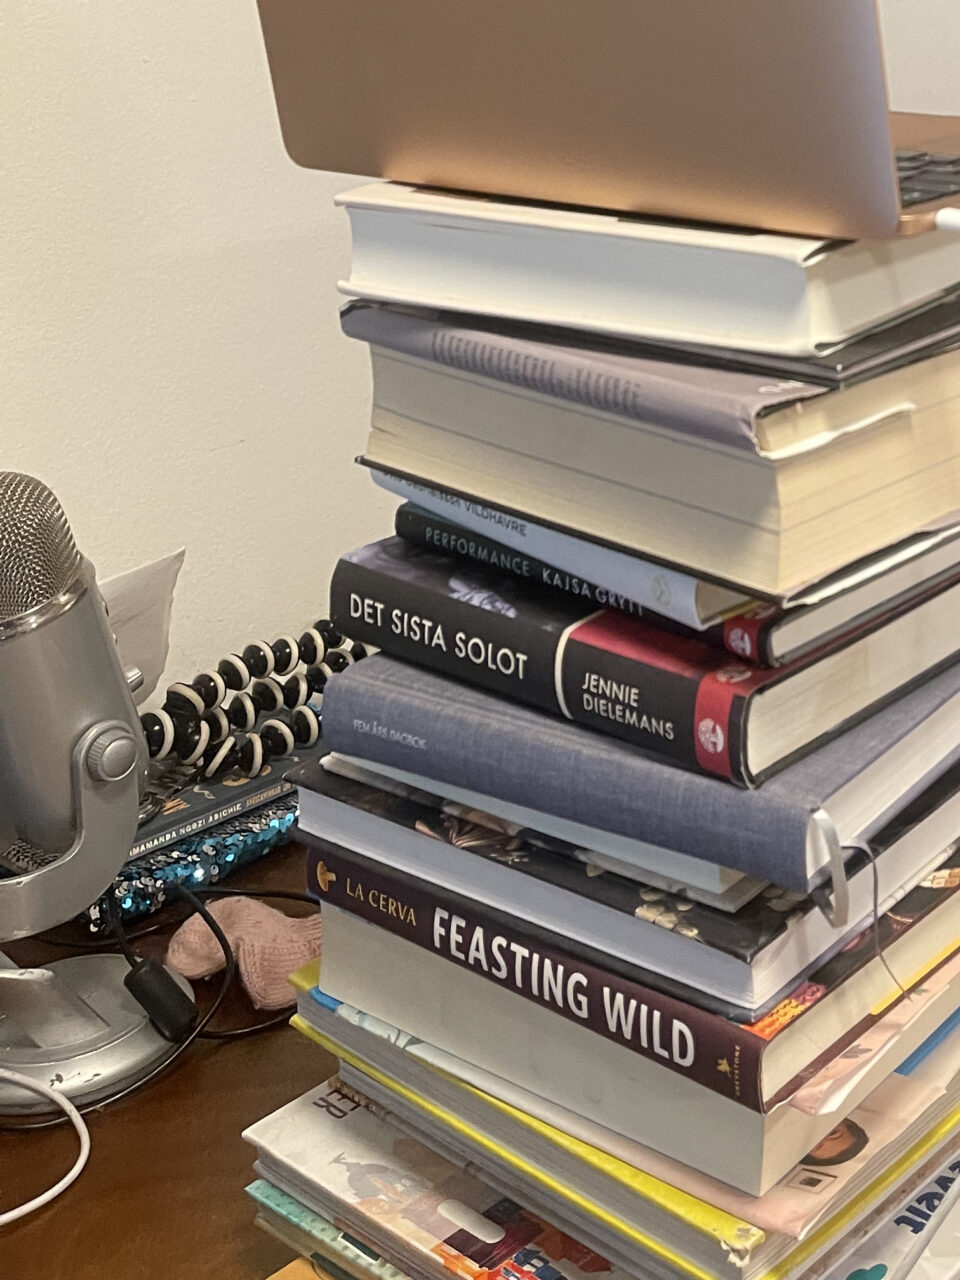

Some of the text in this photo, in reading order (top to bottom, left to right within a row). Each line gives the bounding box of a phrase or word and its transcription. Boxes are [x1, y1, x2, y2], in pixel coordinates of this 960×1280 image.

[425, 526, 530, 577] PERFORMANCE
[542, 568, 591, 599] KAJSA
[350, 593, 528, 680] DET SISTA SOLOT
[582, 672, 640, 708] JENNIE
[582, 693, 675, 741] DIELEMANS
[179, 819, 206, 835] NGOZI
[208, 803, 243, 823] ADICHIE
[346, 877, 417, 926] LA CERVA
[433, 906, 695, 1068] FEASTING WILD
